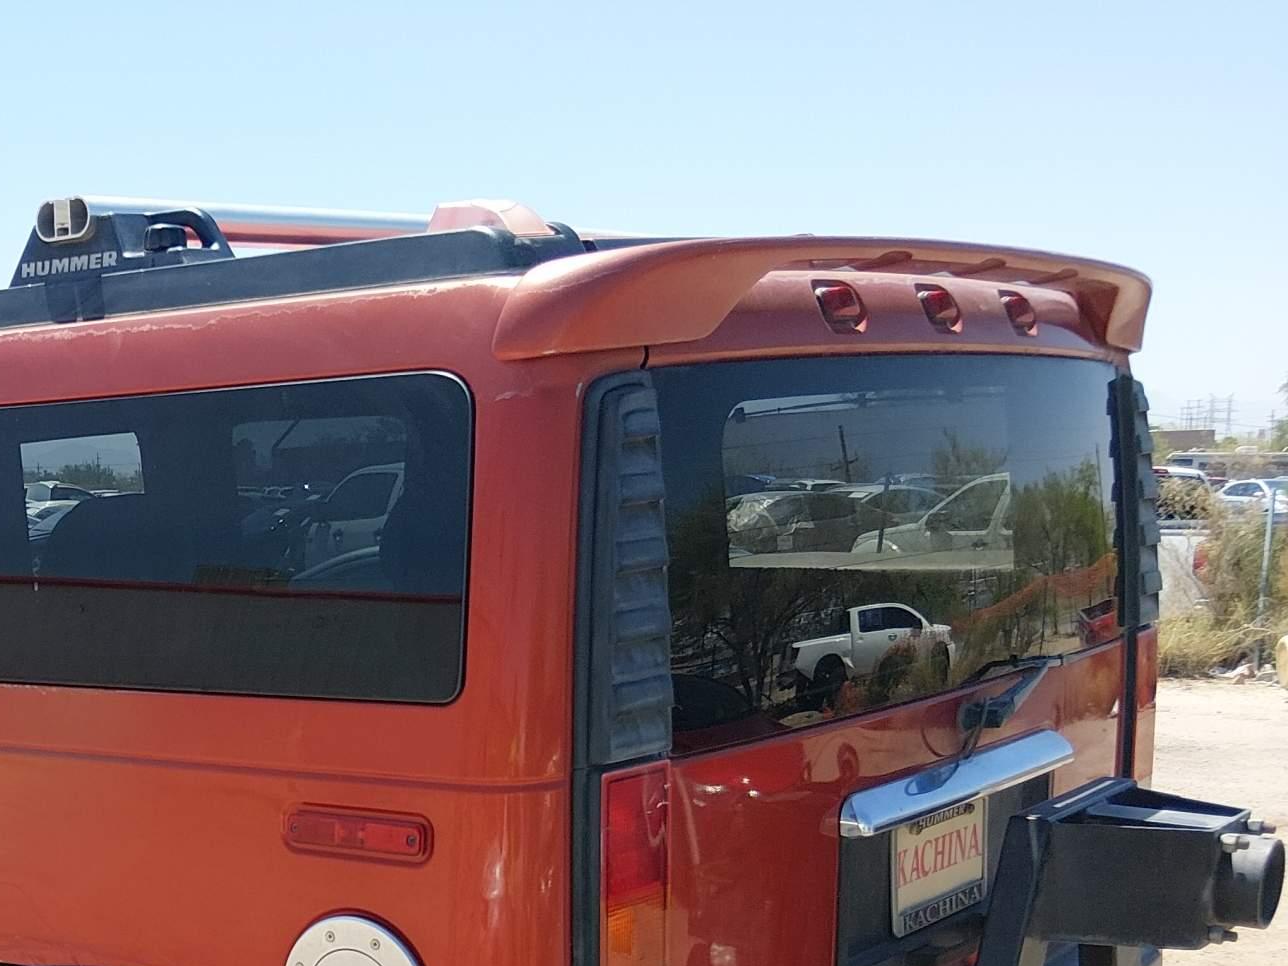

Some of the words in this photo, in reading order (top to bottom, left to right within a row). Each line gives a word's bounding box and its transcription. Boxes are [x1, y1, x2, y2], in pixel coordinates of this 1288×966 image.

[21, 250, 118, 278] HUMMER
[918, 803, 968, 831] HUMMER
[896, 823, 982, 889] KACHINA
[904, 882, 982, 931] KACHINA
